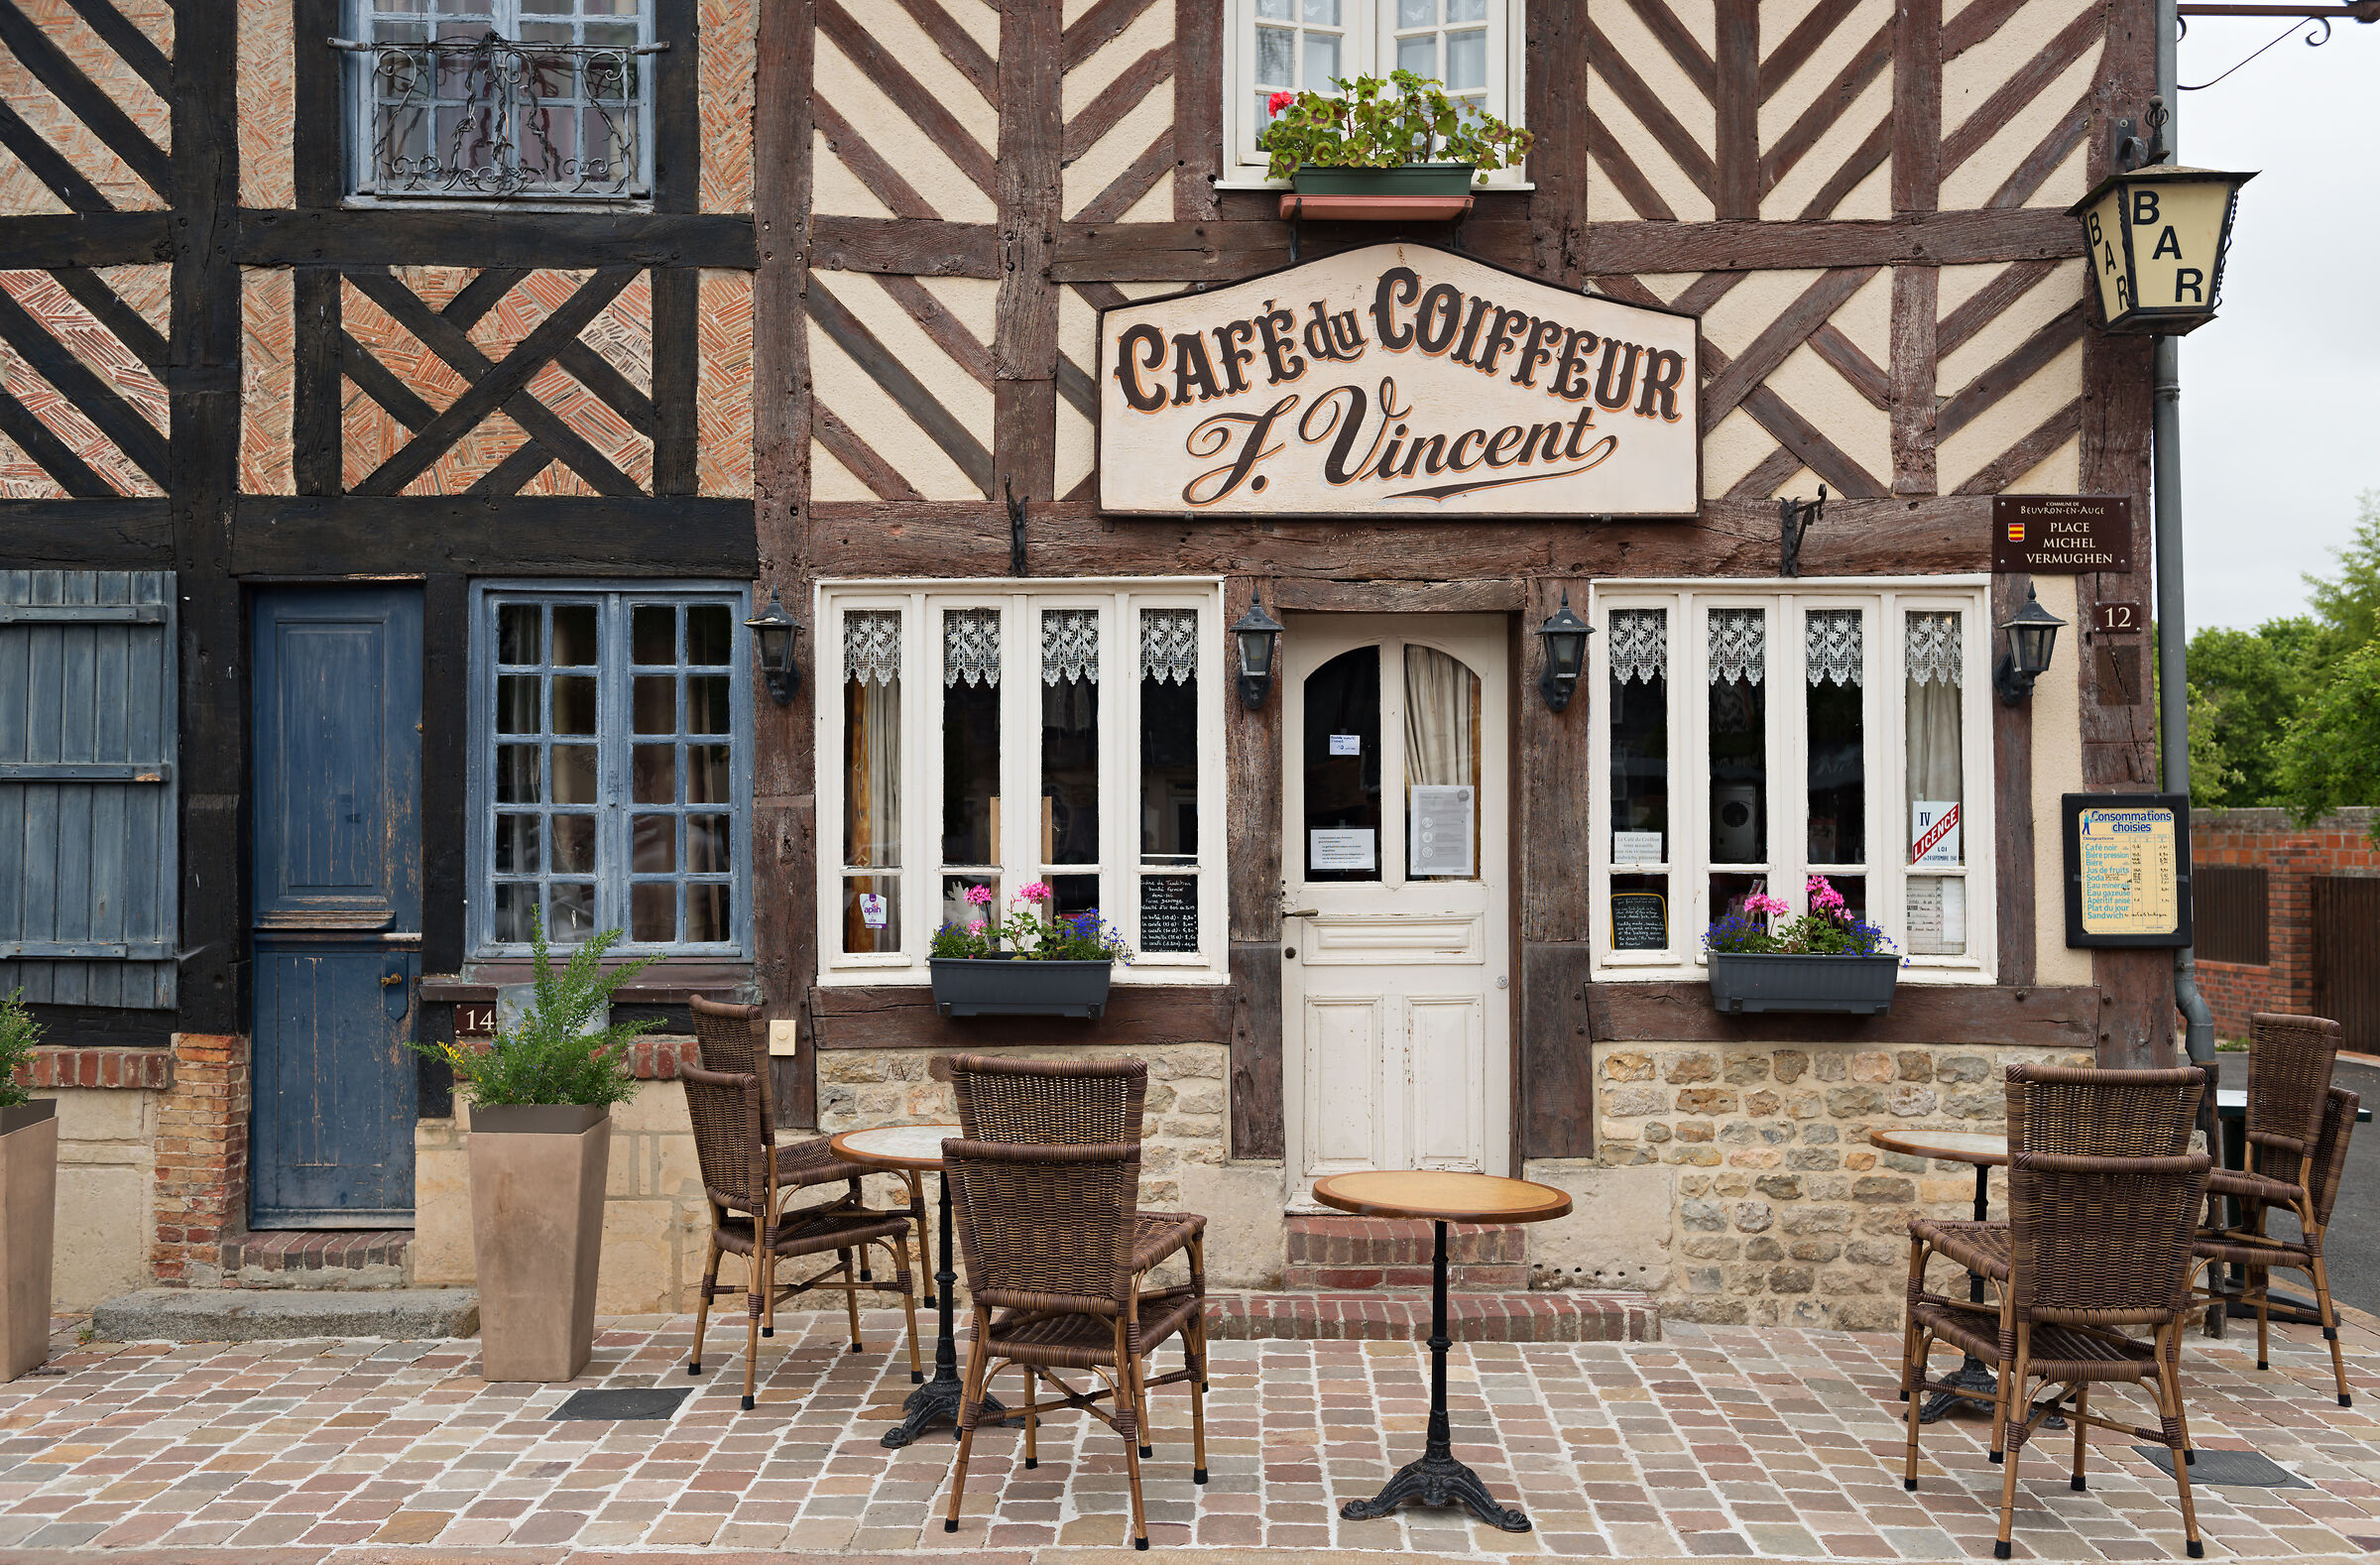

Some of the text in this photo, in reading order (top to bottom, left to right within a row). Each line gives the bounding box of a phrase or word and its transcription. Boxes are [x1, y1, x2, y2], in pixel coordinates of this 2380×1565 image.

[2132, 189, 2204, 302] BAR
[2088, 210, 2131, 311] BAR
[1114, 267, 1688, 422] CAFÉ du COIFFEUR
[1297, 376, 1619, 502] Vincent
[2050, 522, 2090, 533] PLACE
[2043, 538, 2096, 548] MICHEL
[2026, 552, 2113, 564] VERMUGHEN
[2104, 606, 2132, 628] 12
[1919, 811, 1932, 827] IV
[2091, 810, 2172, 822] Consommations
[1914, 807, 1958, 861] LICENCE
[2112, 821, 2152, 832] choisies
[2103, 852, 2130, 861] pression
[465, 1009, 495, 1030] 14
